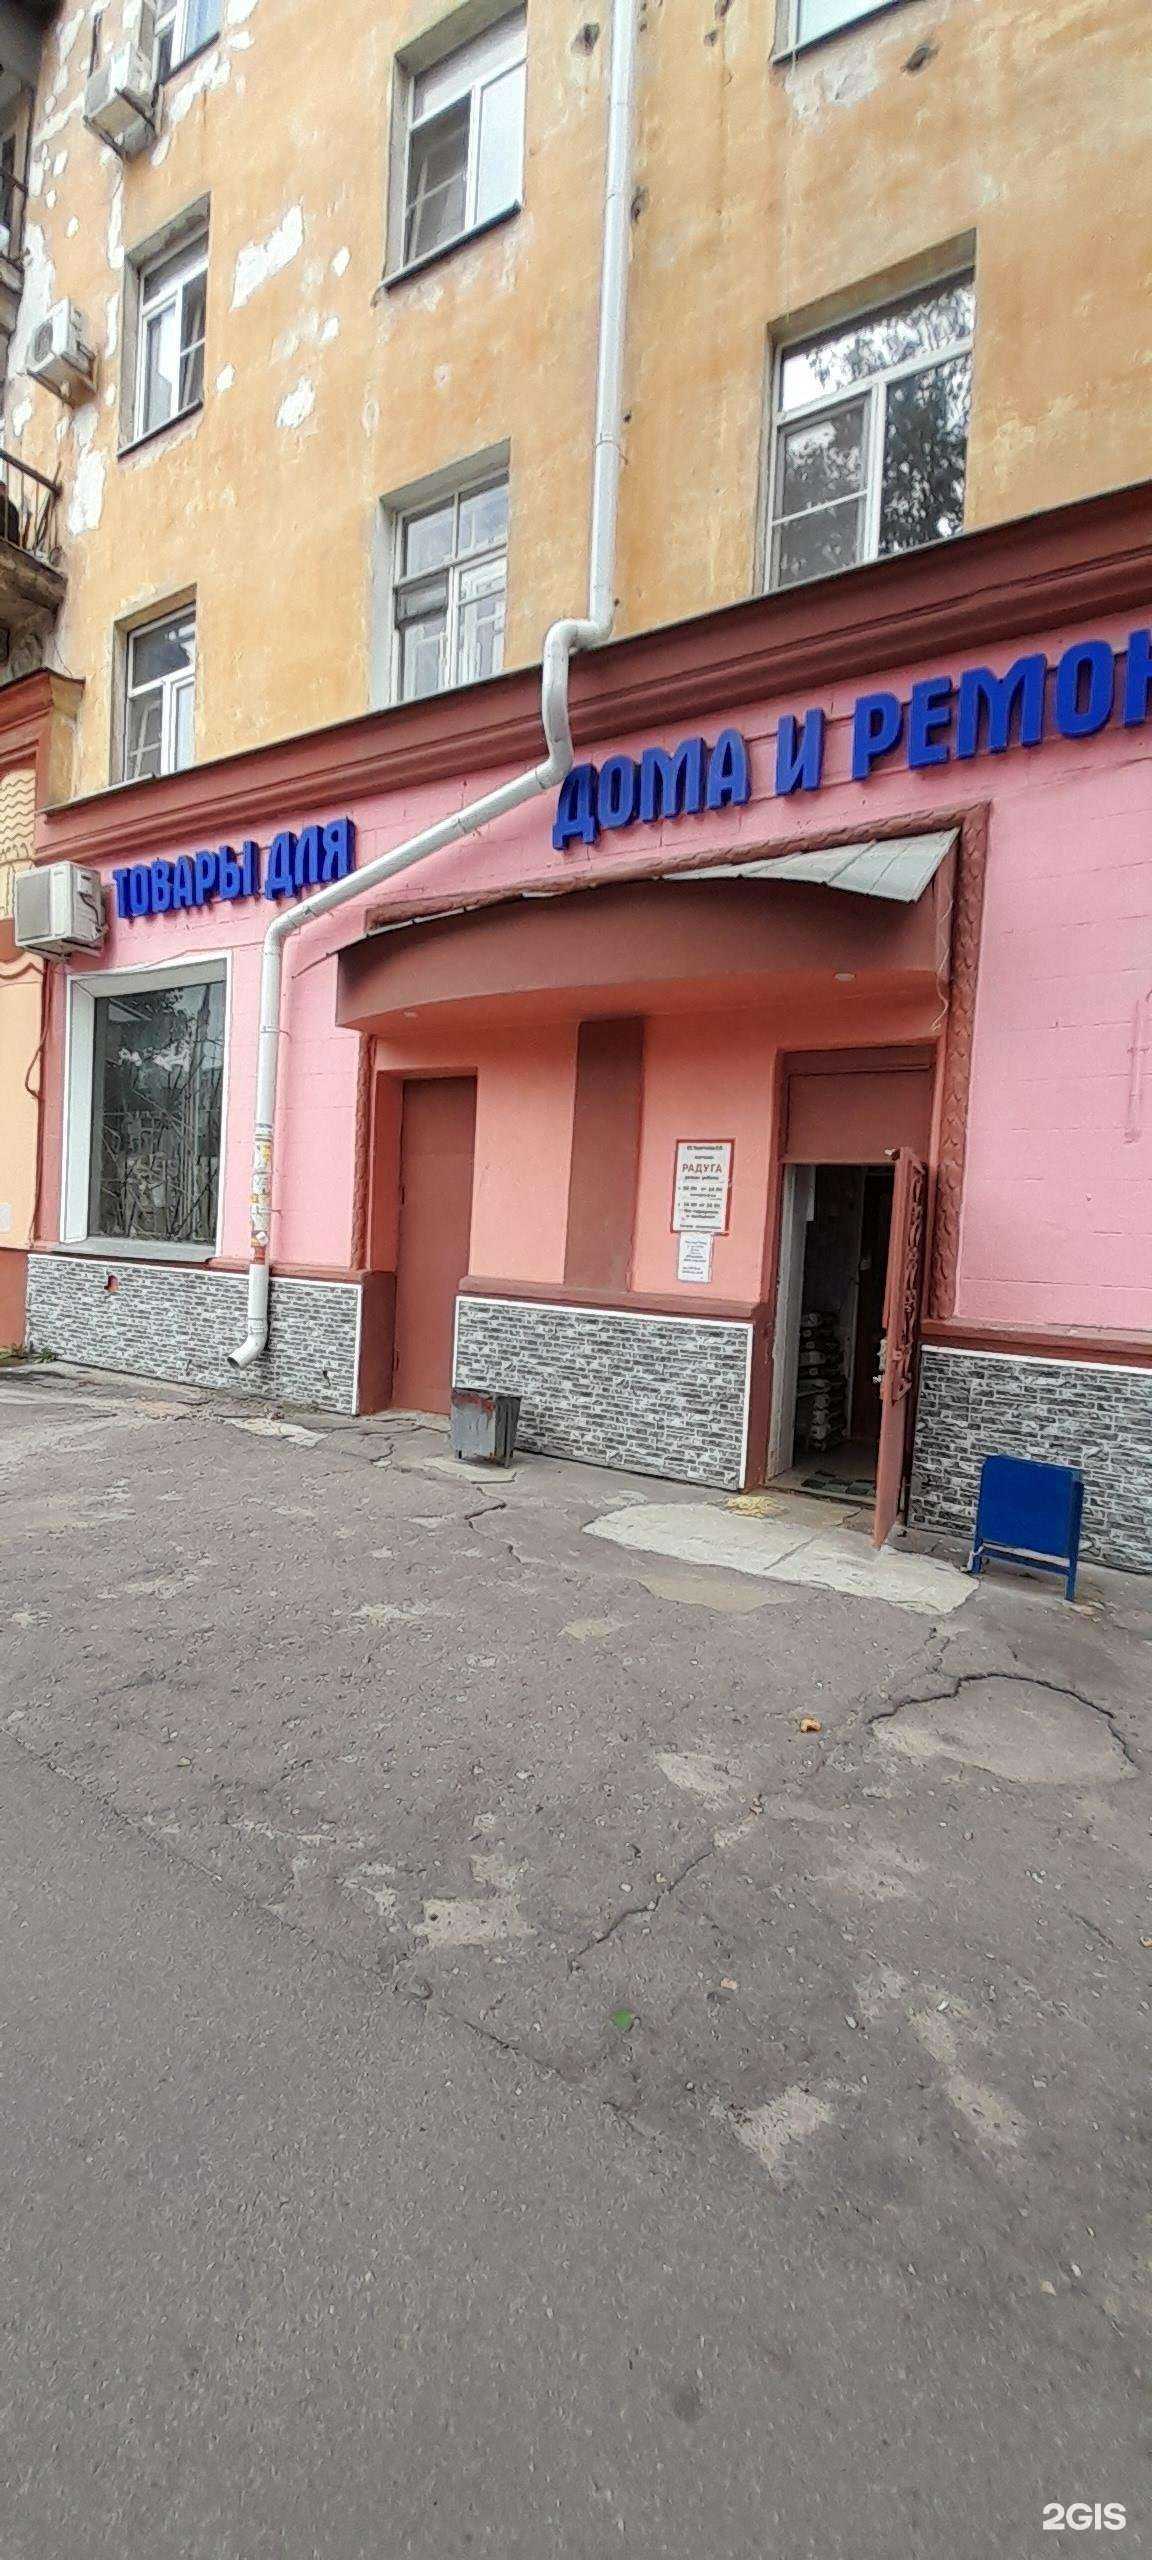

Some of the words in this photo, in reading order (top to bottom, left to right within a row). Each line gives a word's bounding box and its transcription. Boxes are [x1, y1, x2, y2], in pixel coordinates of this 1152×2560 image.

[112, 839, 261, 918] ТОВАРЫ
[264, 818, 354, 902] ДЛЯ
[552, 729, 750, 848] ДОМА
[774, 709, 823, 795] И
[682, 1163, 722, 1174] РАДУГА
